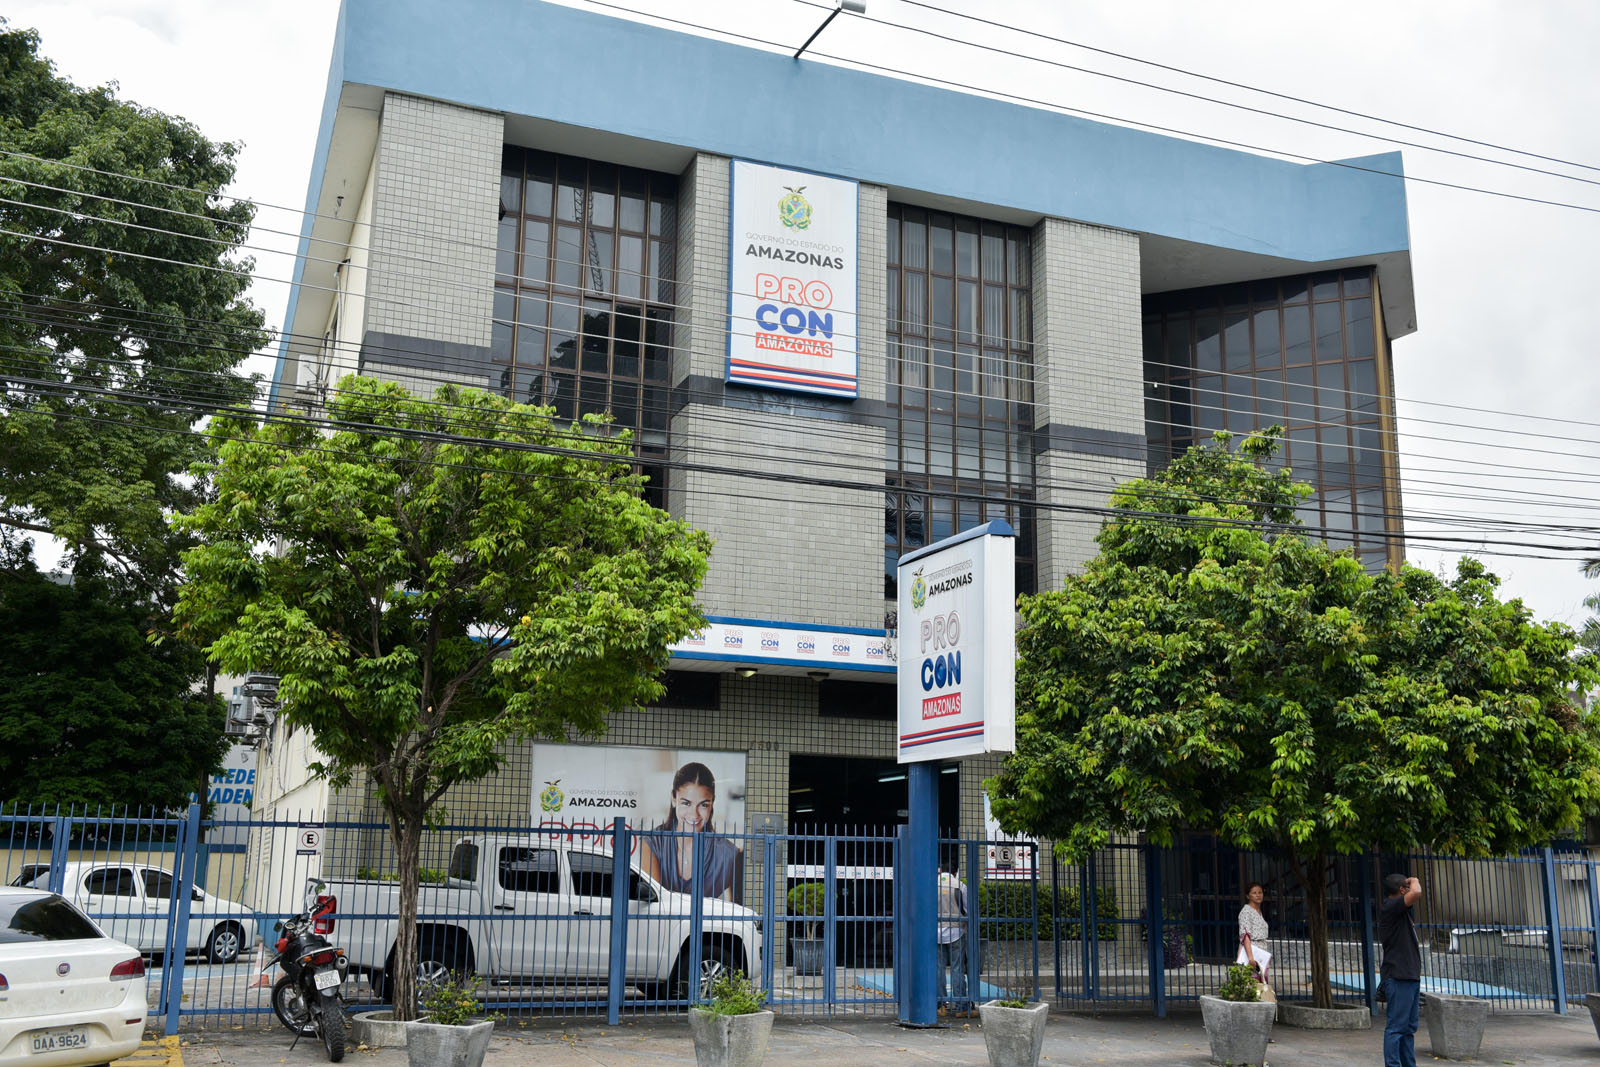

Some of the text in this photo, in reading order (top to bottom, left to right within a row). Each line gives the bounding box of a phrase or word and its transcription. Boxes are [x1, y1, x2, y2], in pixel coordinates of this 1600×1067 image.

[745, 231, 844, 254] GOVERNO DO ESTADO DO
[745, 243, 844, 270] AMAZONAS
[755, 272, 833, 310] PRO
[755, 303, 834, 339] CON
[756, 334, 833, 357] AMAZONAS
[929, 572, 973, 597] AMAZONAS
[921, 610, 961, 654] PRO
[724, 636, 743, 644] CON
[761, 639, 779, 647] CON
[833, 644, 850, 652] CON
[866, 647, 884, 655] CON
[921, 650, 961, 692] CON
[923, 695, 961, 718] AMAZONAS
[569, 797, 637, 808] AMAZONAS
[307, 834, 314, 844] E
[1003, 851, 1008, 860] E
